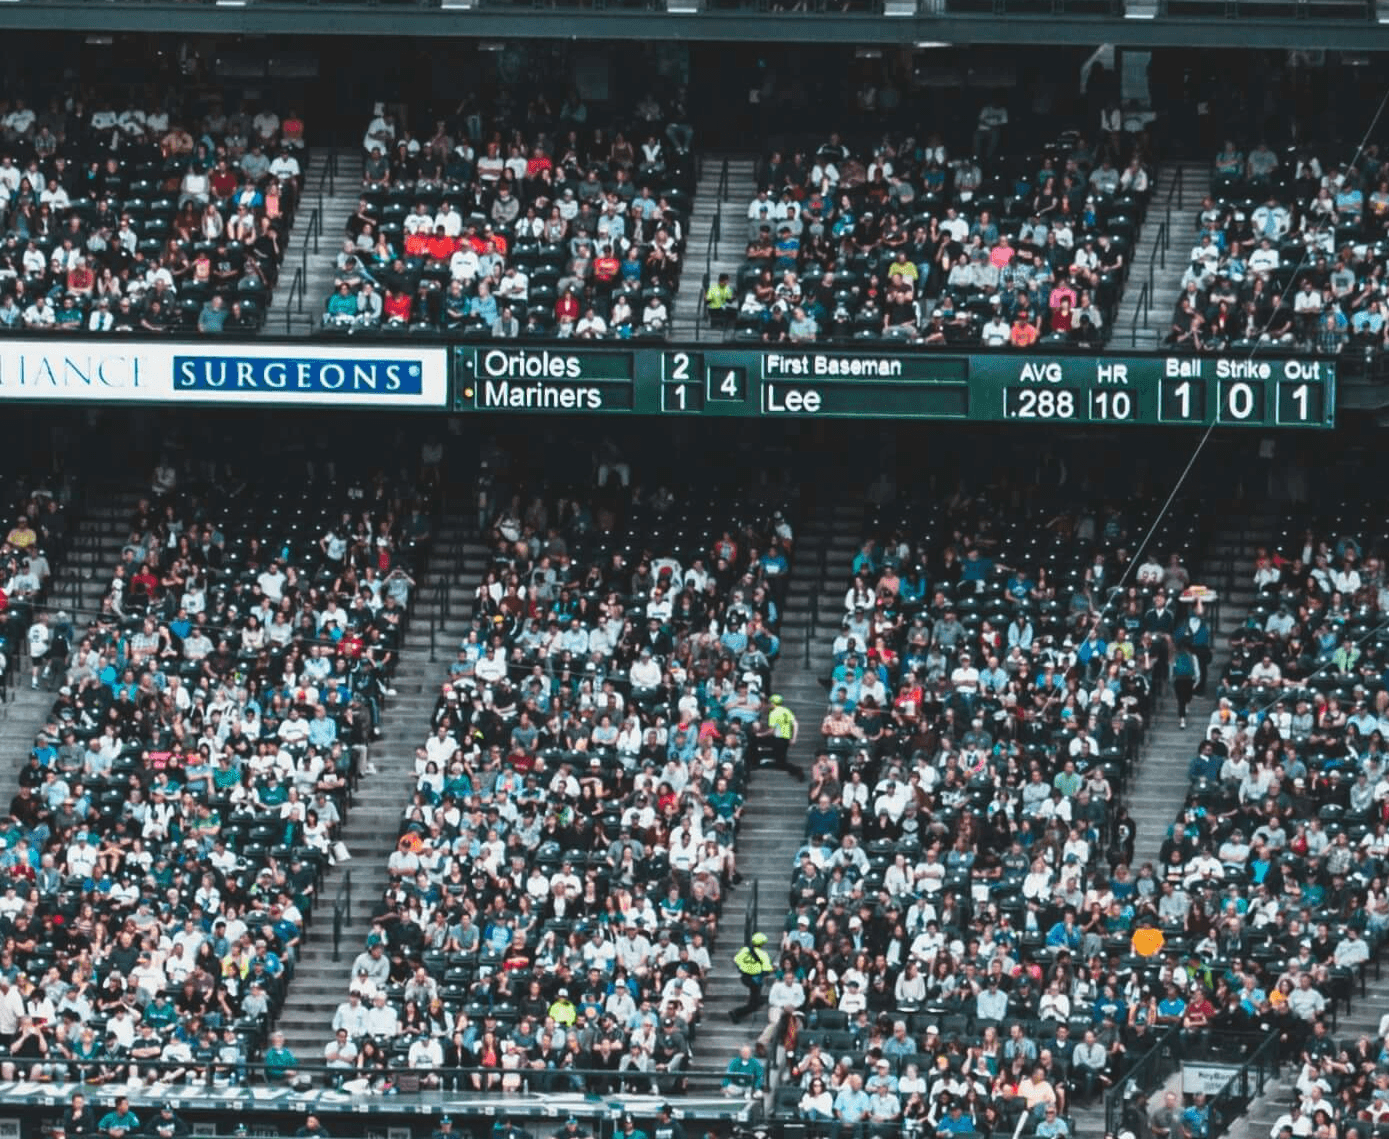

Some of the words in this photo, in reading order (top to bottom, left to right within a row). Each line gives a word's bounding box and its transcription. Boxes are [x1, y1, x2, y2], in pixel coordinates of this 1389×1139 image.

[181, 359, 402, 391] SURGEONS
[485, 350, 582, 379] Orioles
[672, 353, 690, 380] 2
[767, 354, 809, 375] First
[814, 355, 902, 377] Baseman
[1019, 363, 1063, 383] AVG
[1097, 364, 1128, 384] HR
[1166, 358, 1200, 378] Ball
[1216, 359, 1271, 380] Strike
[1284, 361, 1320, 381] Out
[485, 381, 602, 410] Mariners
[674, 384, 687, 410] 1
[720, 371, 738, 397] 4
[768, 385, 821, 412] Lee
[1010, 390, 1074, 418] .288
[1096, 392, 1131, 419] 10
[1174, 382, 1191, 418] 1
[1229, 382, 1254, 419] 0
[1292, 384, 1309, 420] 1
